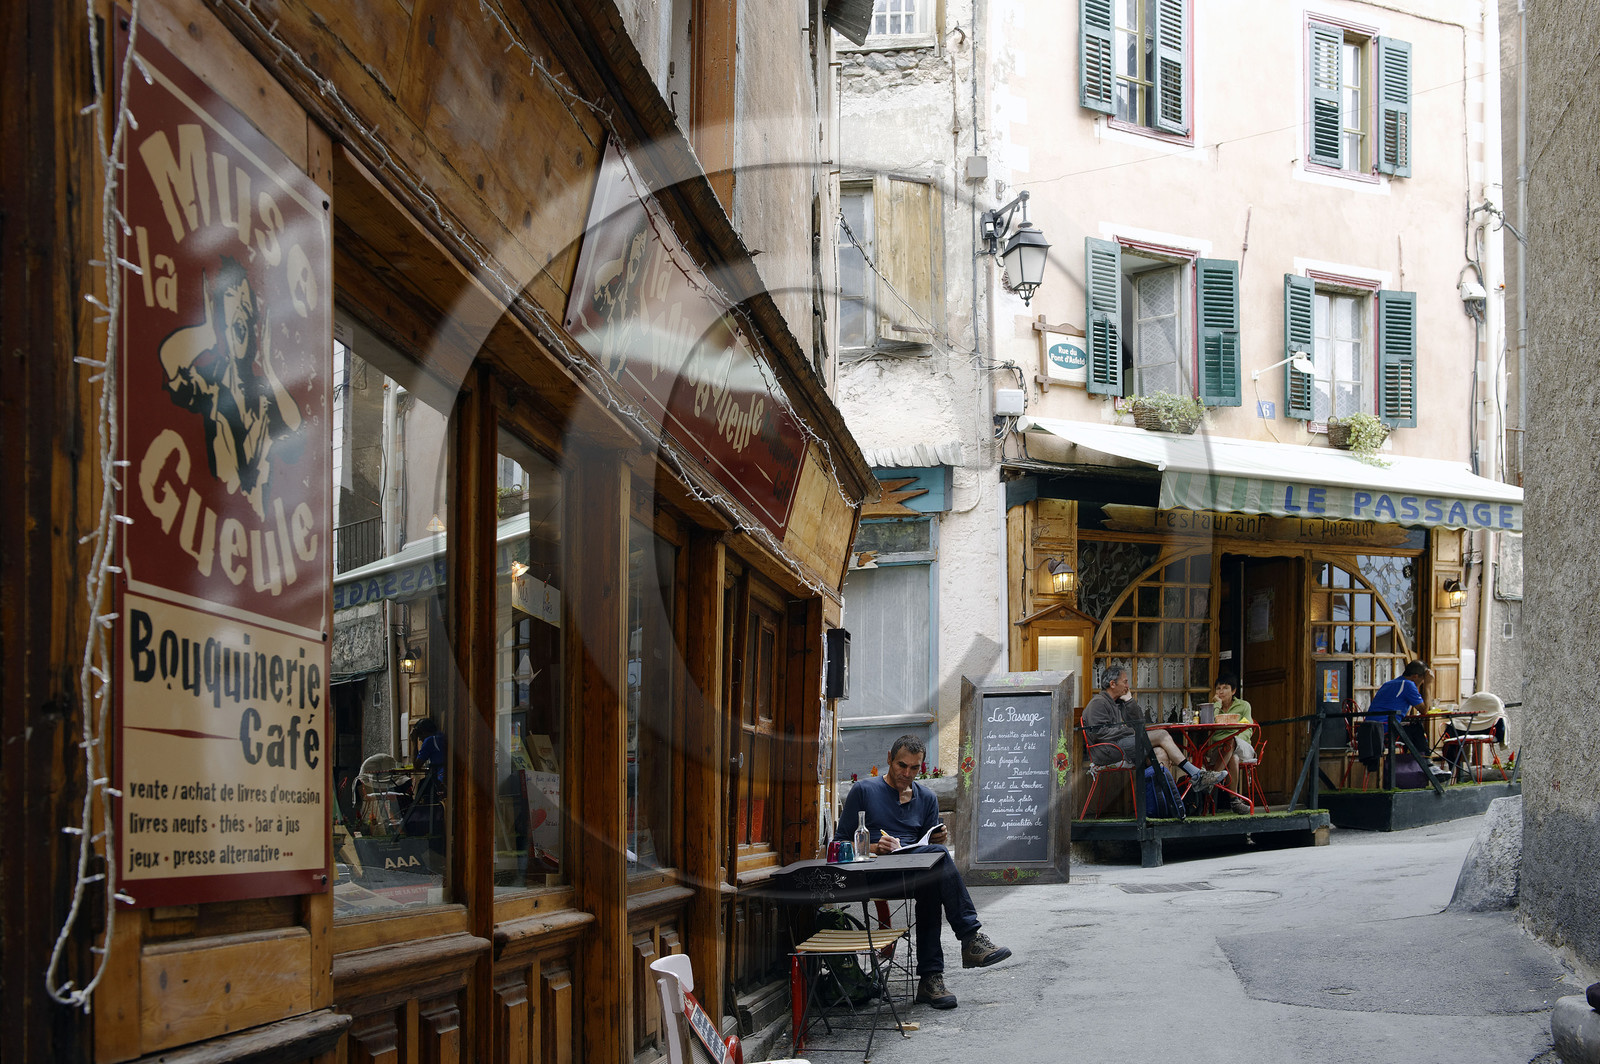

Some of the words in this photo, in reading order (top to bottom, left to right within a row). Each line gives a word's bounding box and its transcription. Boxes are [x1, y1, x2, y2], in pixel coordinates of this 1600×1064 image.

[135, 226, 178, 314] la
[1050, 352, 1064, 362] Pont
[1058, 345, 1069, 355] Rue
[1070, 348, 1078, 356] du
[1263, 404, 1270, 417] 6
[1284, 485, 1327, 513] LE
[1354, 491, 1514, 529] PASSAGE
[1154, 510, 1266, 533] restaurant
[1300, 519, 1315, 537] Le
[130, 608, 320, 710] Bouquinerie
[987, 707, 1005, 723] Le
[1005, 706, 1045, 727] Passage
[239, 707, 320, 770] Café
[1013, 742, 1021, 751] de
[1021, 756, 1029, 764] du
[1009, 780, 1018, 789] du
[1020, 780, 1044, 789] boucher
[129, 780, 168, 799] vente
[180, 781, 216, 802] achat
[220, 783, 234, 802] de
[237, 783, 267, 803] livres
[270, 783, 320, 805] d'occasion
[998, 794, 1015, 806] petits
[1018, 794, 1033, 807] plats
[1024, 805, 1038, 815] chef
[129, 813, 168, 834] livres
[172, 815, 208, 835] neufs
[219, 813, 245, 834] thés
[255, 816, 273, 834] bar
[276, 815, 283, 833] à
[285, 816, 300, 837] jus
[1034, 818, 1043, 827] de
[1006, 832, 1041, 846] montagne
[129, 849, 160, 873] jeux
[173, 848, 216, 870] presse
[384, 855, 421, 869] AAA
